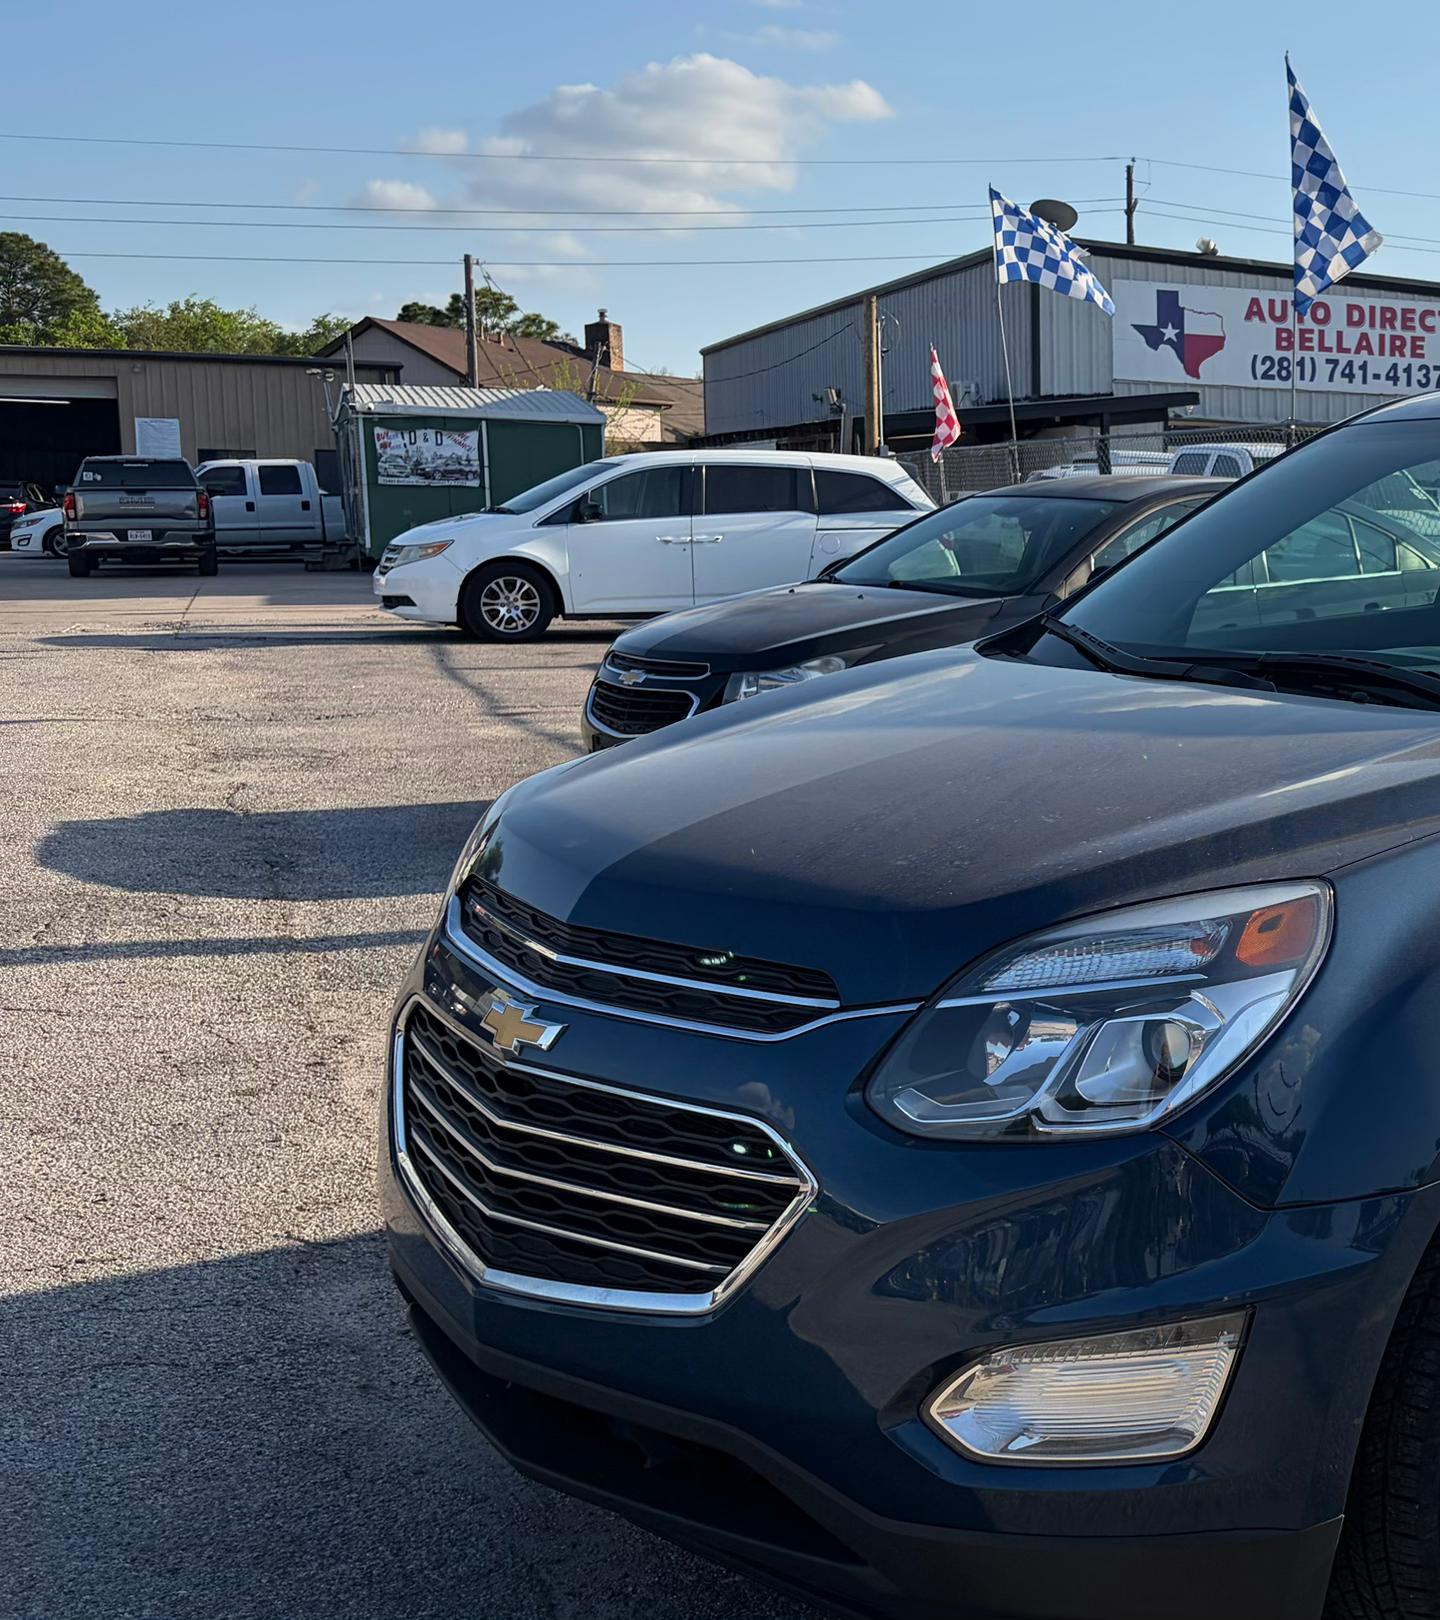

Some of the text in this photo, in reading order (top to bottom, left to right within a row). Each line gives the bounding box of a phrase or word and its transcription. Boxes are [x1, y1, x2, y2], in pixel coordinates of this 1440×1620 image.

[1244, 297, 1332, 327] AUO
[1276, 327, 1426, 359] BELLAIRE
[1251, 354, 1317, 383] (281)
[408, 430, 417, 446] D
[422, 432, 429, 443] &
[435, 430, 444, 447] D
